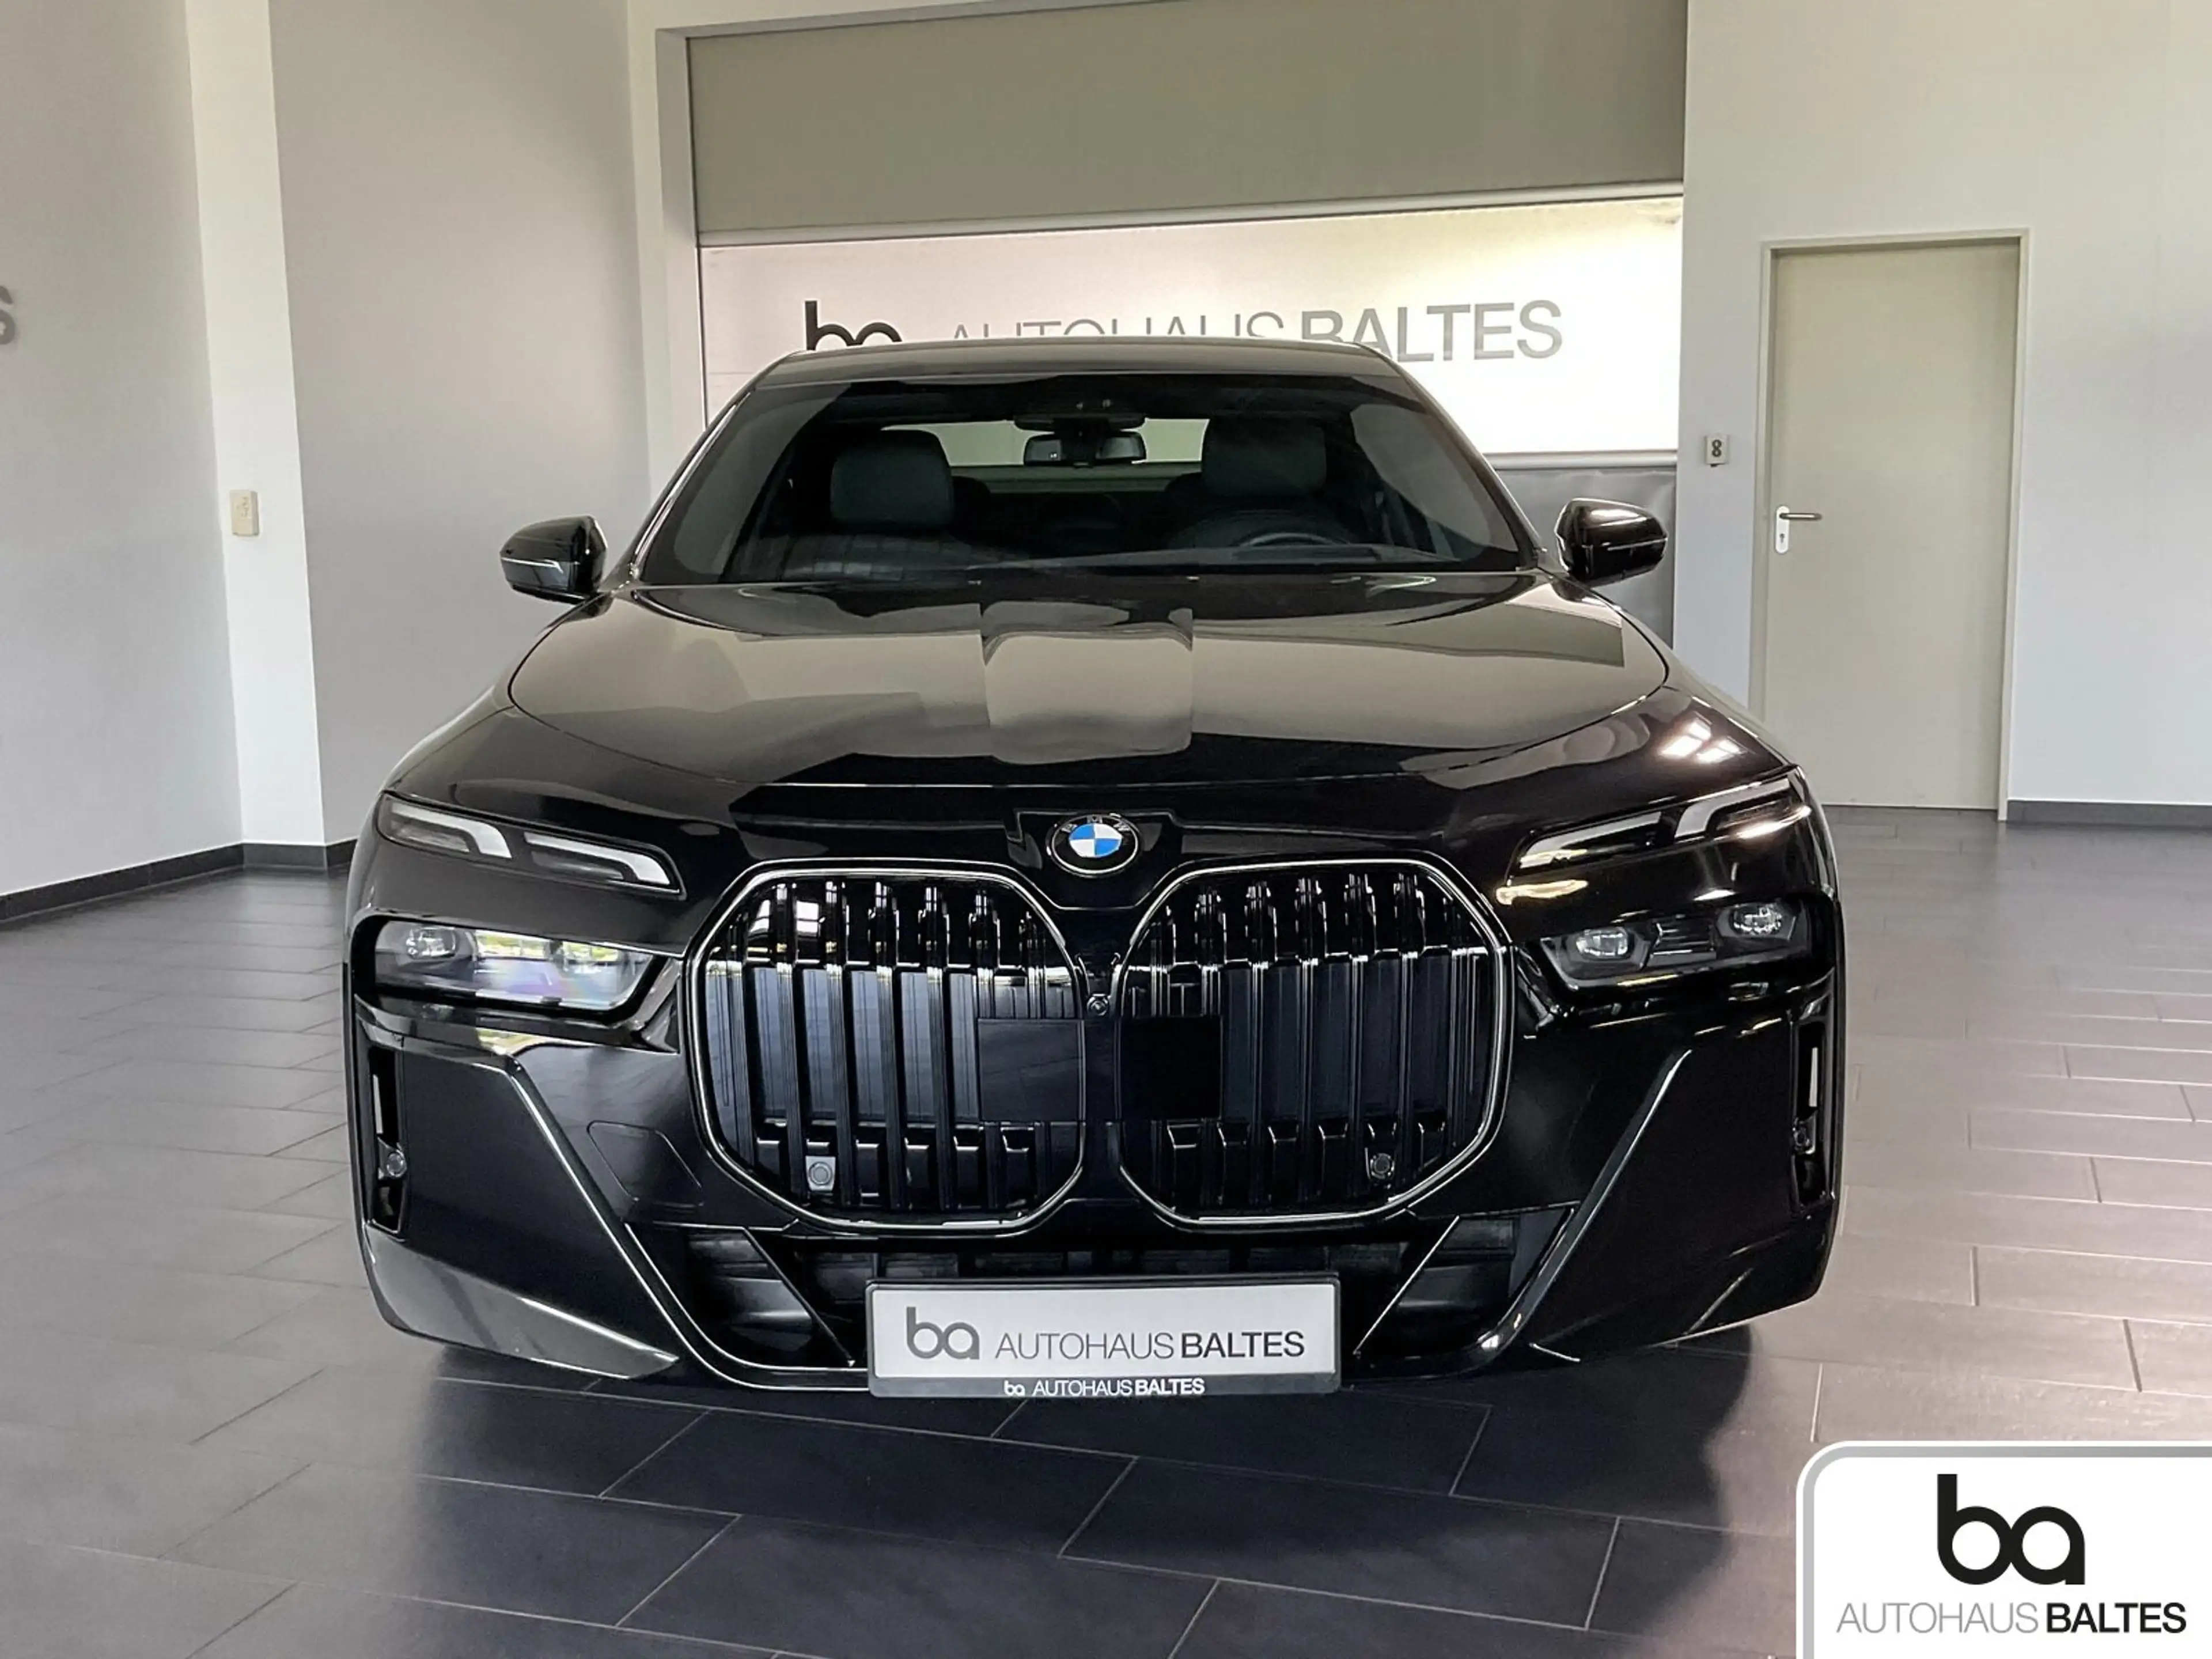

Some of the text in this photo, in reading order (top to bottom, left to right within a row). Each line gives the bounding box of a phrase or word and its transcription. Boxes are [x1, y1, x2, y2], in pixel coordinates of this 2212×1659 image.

[1301, 300, 1562, 362] BALTES
[906, 1306, 980, 1360] ba
[995, 1331, 1305, 1360] AUTOHAUS BALTES
[1003, 1377, 1205, 1396] ba AUTOHAUS BALTES
